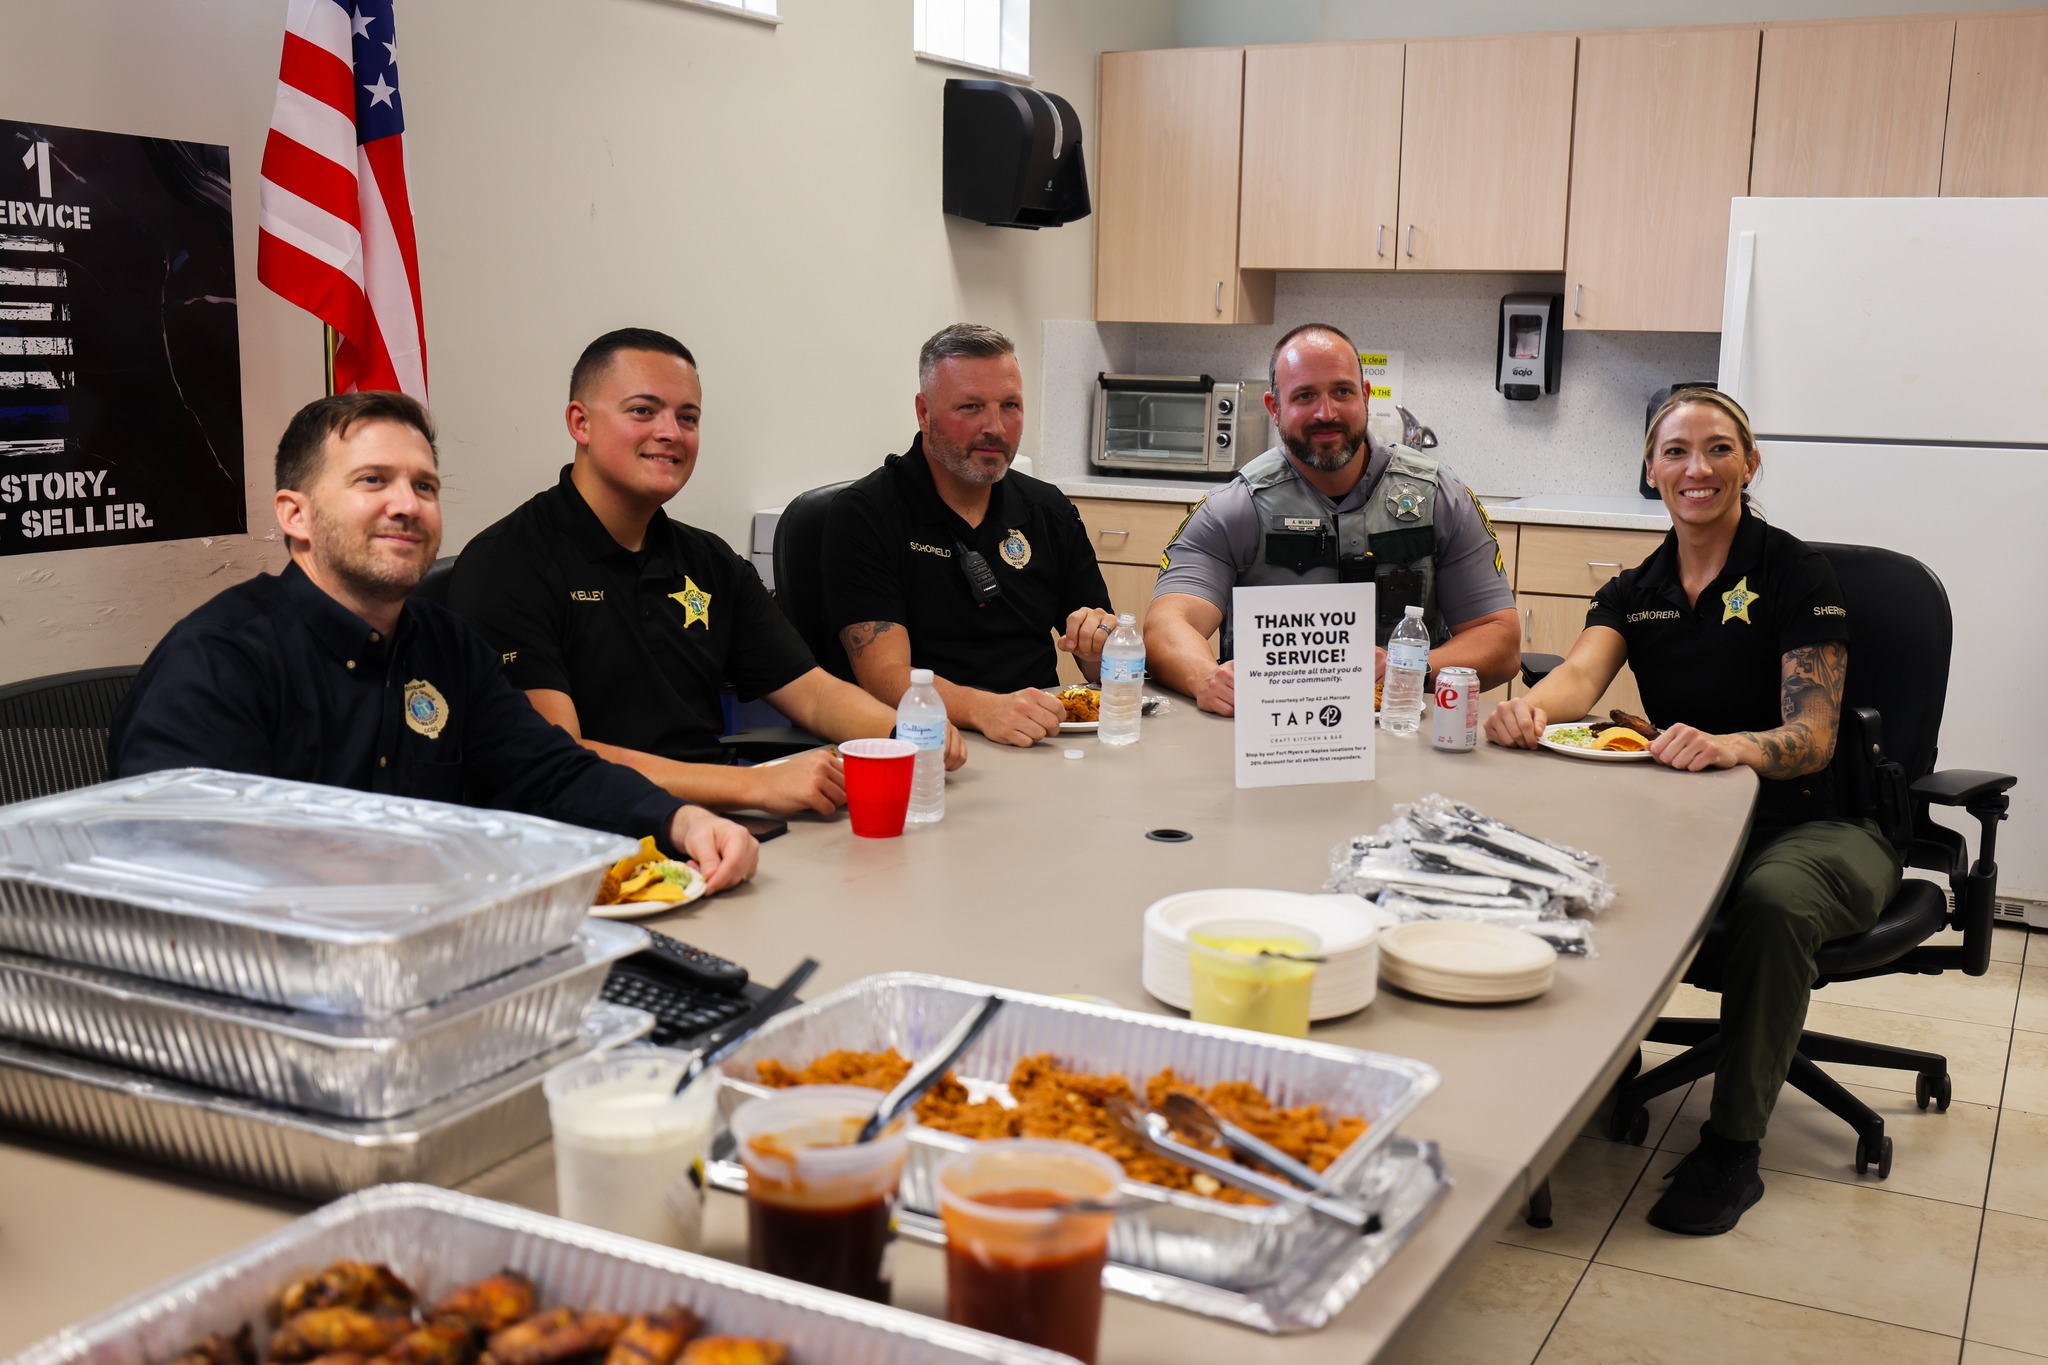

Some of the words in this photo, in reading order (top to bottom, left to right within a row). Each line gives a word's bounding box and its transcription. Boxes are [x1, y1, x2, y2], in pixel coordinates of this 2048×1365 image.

[0, 470, 116, 503] STORY.
[21, 503, 154, 538] SELLER.
[570, 590, 604, 601] KELLEY
[1255, 613, 1315, 628] THANK
[1320, 612, 1356, 626] YOU
[1263, 633, 1296, 647] FOR
[1301, 631, 1349, 645] YOUR
[1266, 649, 1345, 665] SERVICE!
[1264, 669, 1306, 678] appreciate
[1296, 676, 1342, 684] community.
[1271, 711, 1314, 726] TAP
[1320, 706, 1338, 727] 42
